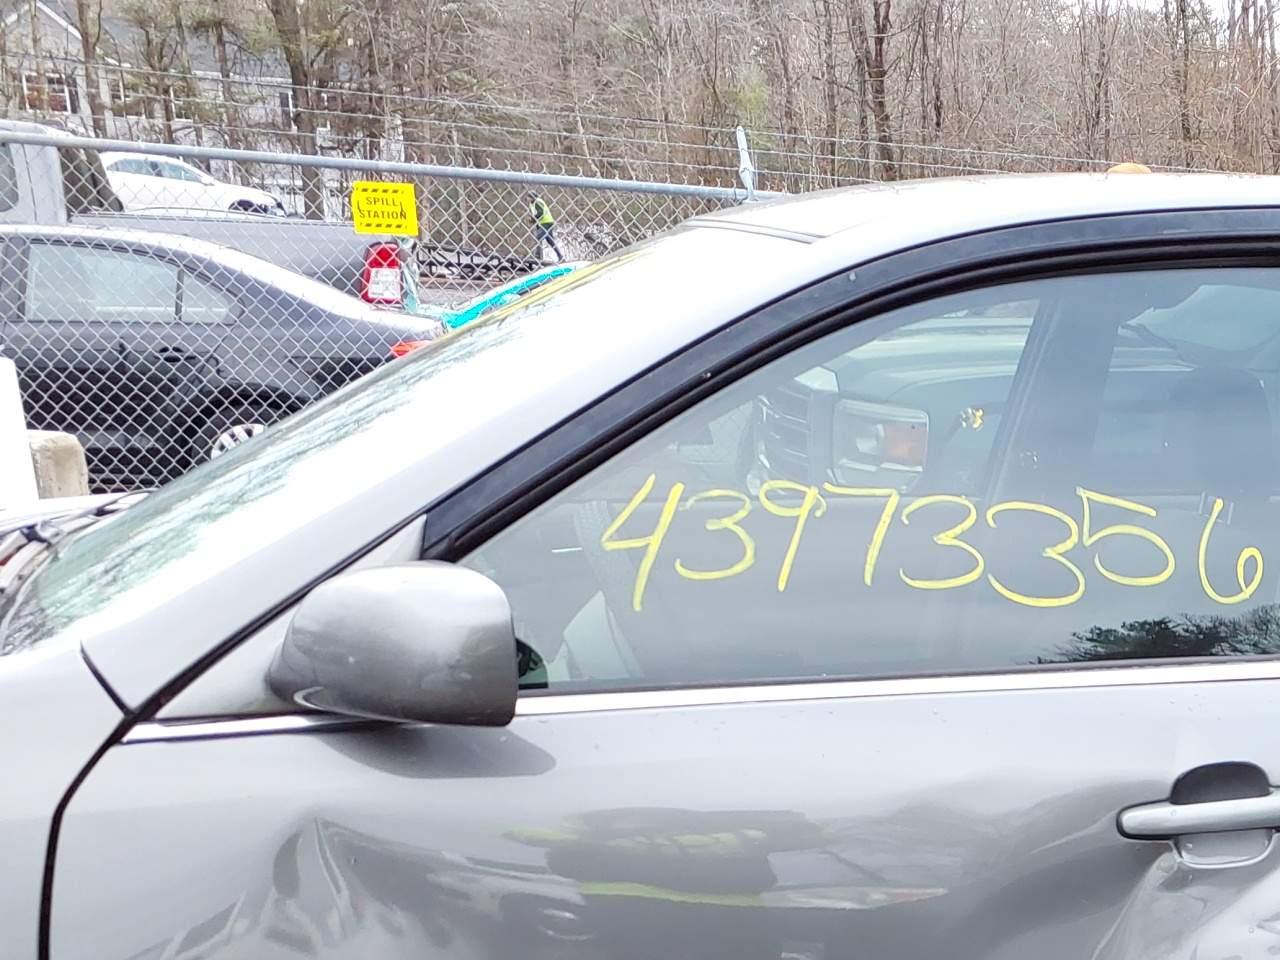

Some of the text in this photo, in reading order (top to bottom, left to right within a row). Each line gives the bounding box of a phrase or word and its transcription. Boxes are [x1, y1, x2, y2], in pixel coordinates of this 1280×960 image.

[365, 196, 399, 206] SPILL
[359, 209, 407, 220] STATION
[601, 473, 1264, 612] 43973356
